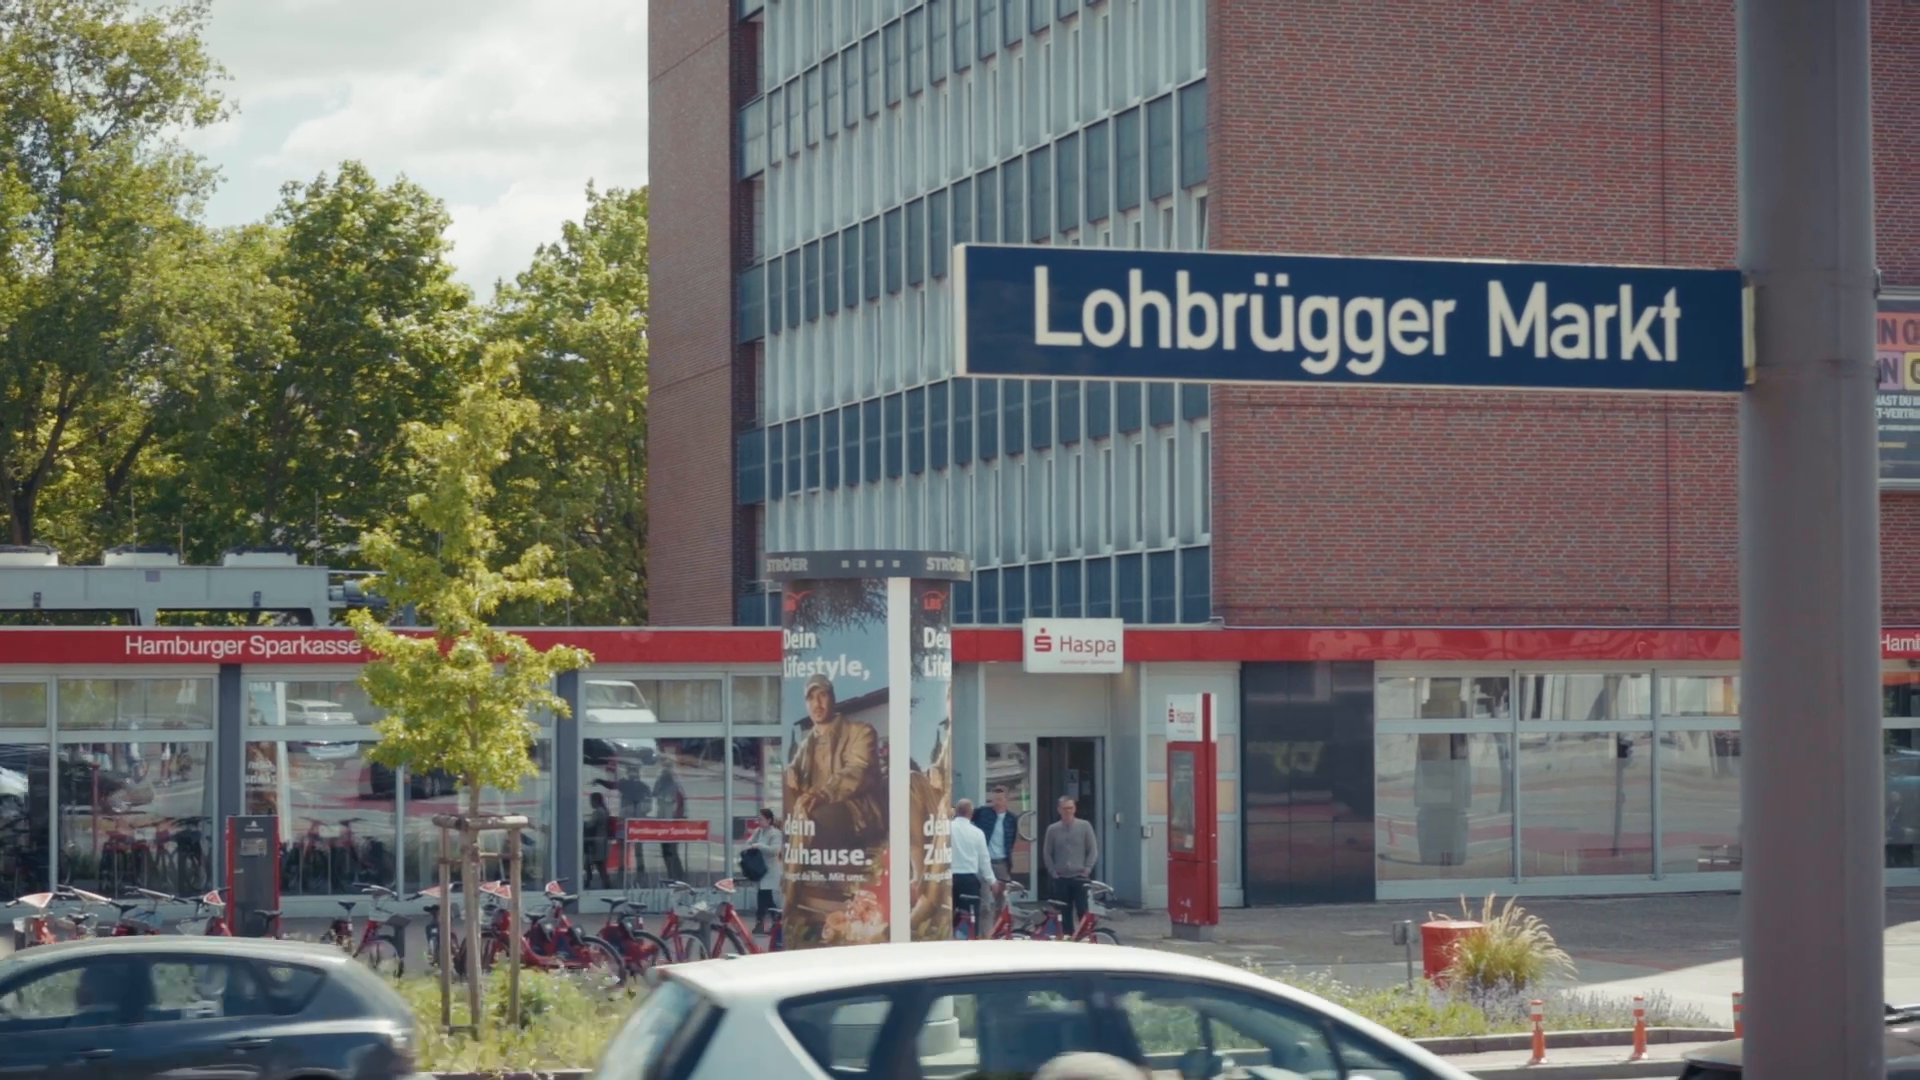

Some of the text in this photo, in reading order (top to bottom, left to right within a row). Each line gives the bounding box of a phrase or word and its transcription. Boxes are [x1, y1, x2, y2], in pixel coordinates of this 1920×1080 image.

[1034, 265, 1681, 376] Lohbrügger Markt
[125, 635, 362, 659] Hamburger Sparkasse
[783, 626, 817, 650] Dein
[1060, 636, 1116, 657] Haspa
[783, 653, 871, 681] Lifestyle,
[784, 812, 816, 836] dein
[784, 842, 874, 866] Zuhause.
